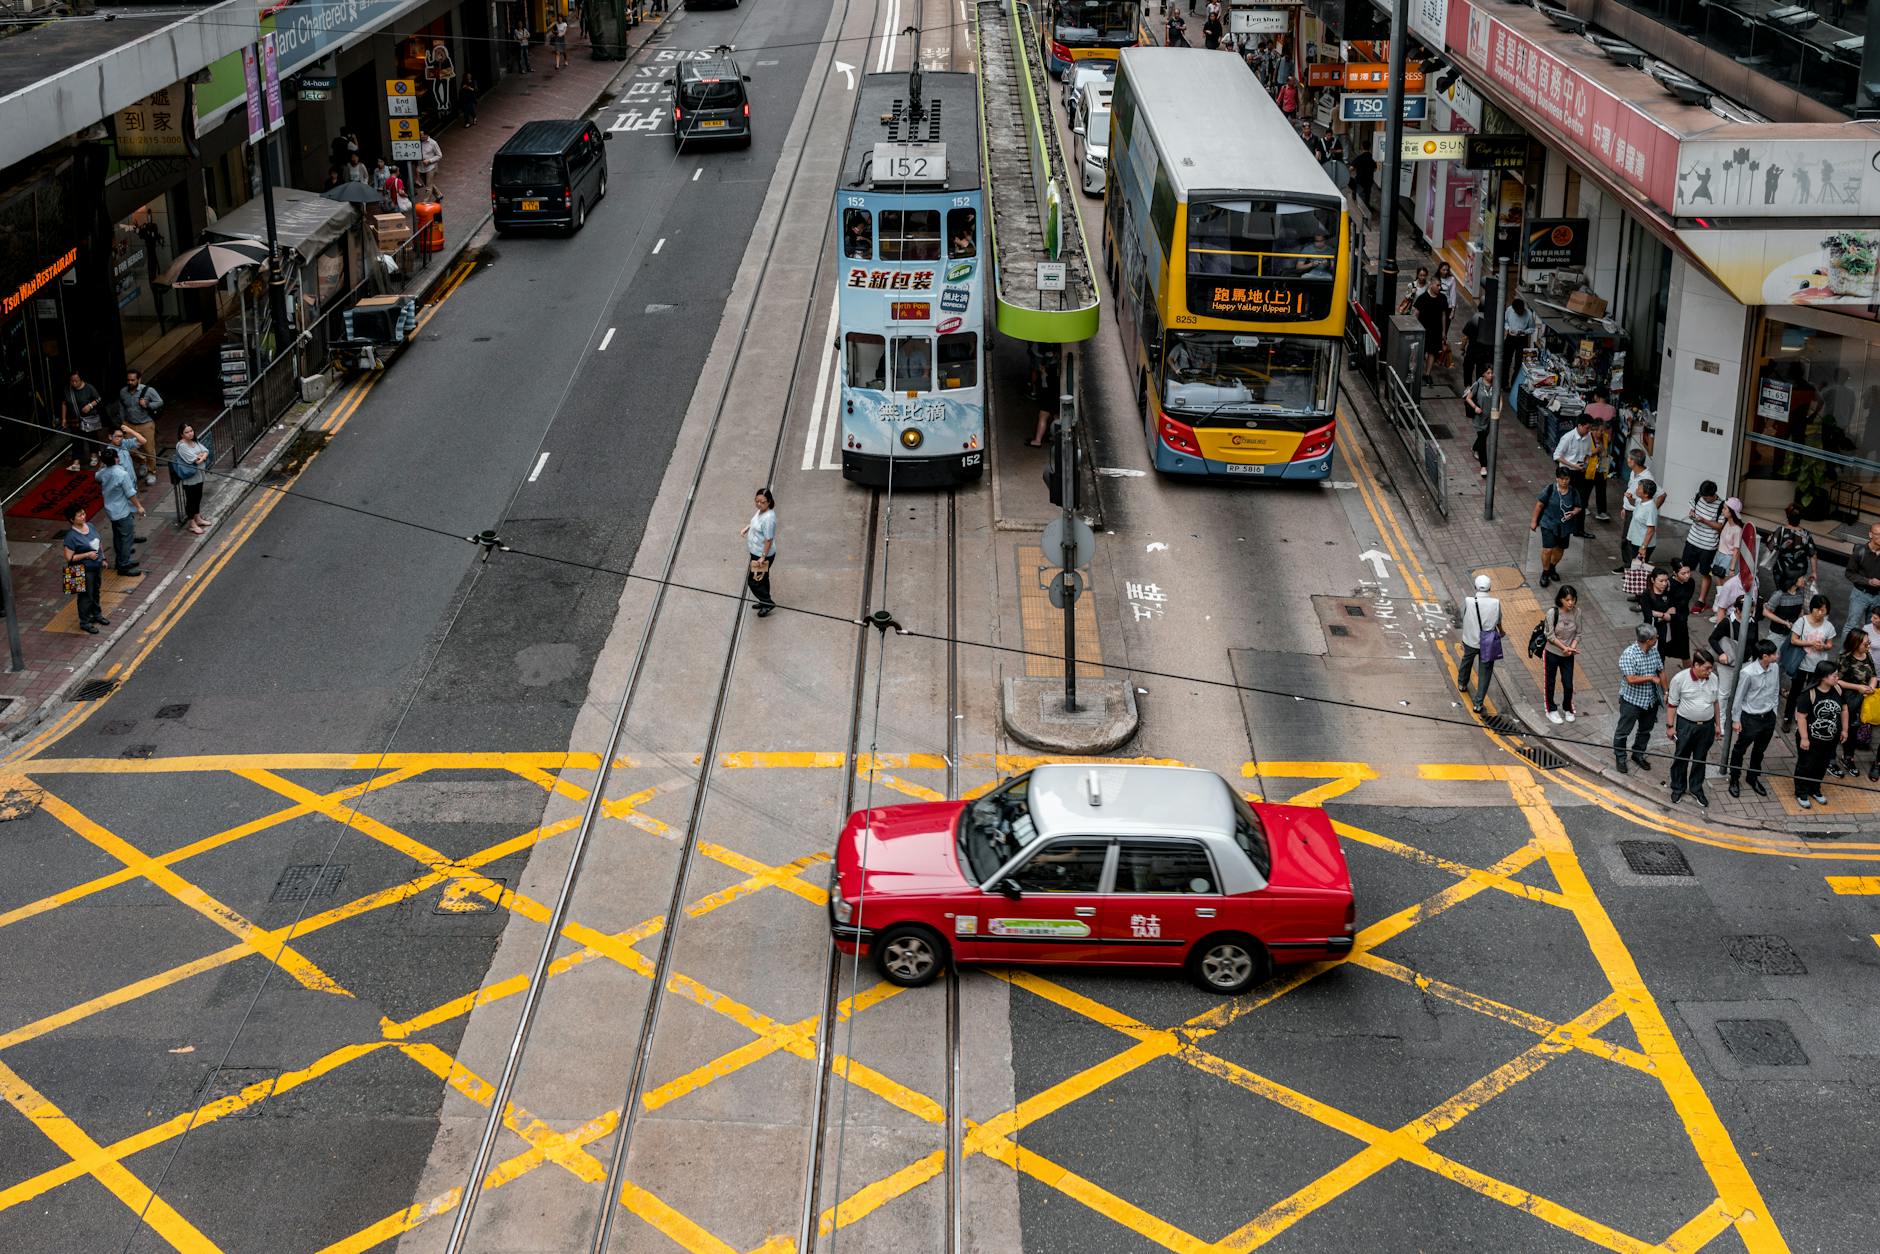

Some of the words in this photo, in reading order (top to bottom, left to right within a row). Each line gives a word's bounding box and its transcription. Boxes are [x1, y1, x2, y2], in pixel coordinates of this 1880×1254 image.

[298, 5, 347, 44] Chartered
[654, 50, 712, 62] BUS
[1457, 79, 1471, 106] SUN
[1494, 64, 1515, 86] Superior
[1515, 75, 1537, 105] Strategy
[1538, 93, 1563, 121] Business
[1563, 111, 1584, 137] Centre
[1353, 99, 1383, 112] TSO
[124, 112, 173, 131] 到家
[607, 107, 666, 131] 站
[888, 157, 928, 178] 152
[847, 197, 865, 207] 152
[951, 196, 970, 207] 152
[2, 291, 20, 315] TSUI
[19, 279, 37, 302] WAH
[35, 247, 78, 290] RESTAURANT
[848, 269, 934, 290] 全新包裝
[1214, 287, 1291, 305] 跑馬地(上)
[1297, 292, 1303, 314] 1
[1212, 302, 1236, 312] Happy
[1237, 303, 1262, 313] Valley
[1262, 304, 1291, 313] (Upper)
[1175, 315, 1197, 325] 8253
[879, 401, 946, 422] 無比滴
[961, 453, 981, 467] 152
[1131, 914, 1161, 926] 的士
[1130, 926, 1160, 938] TAXI
